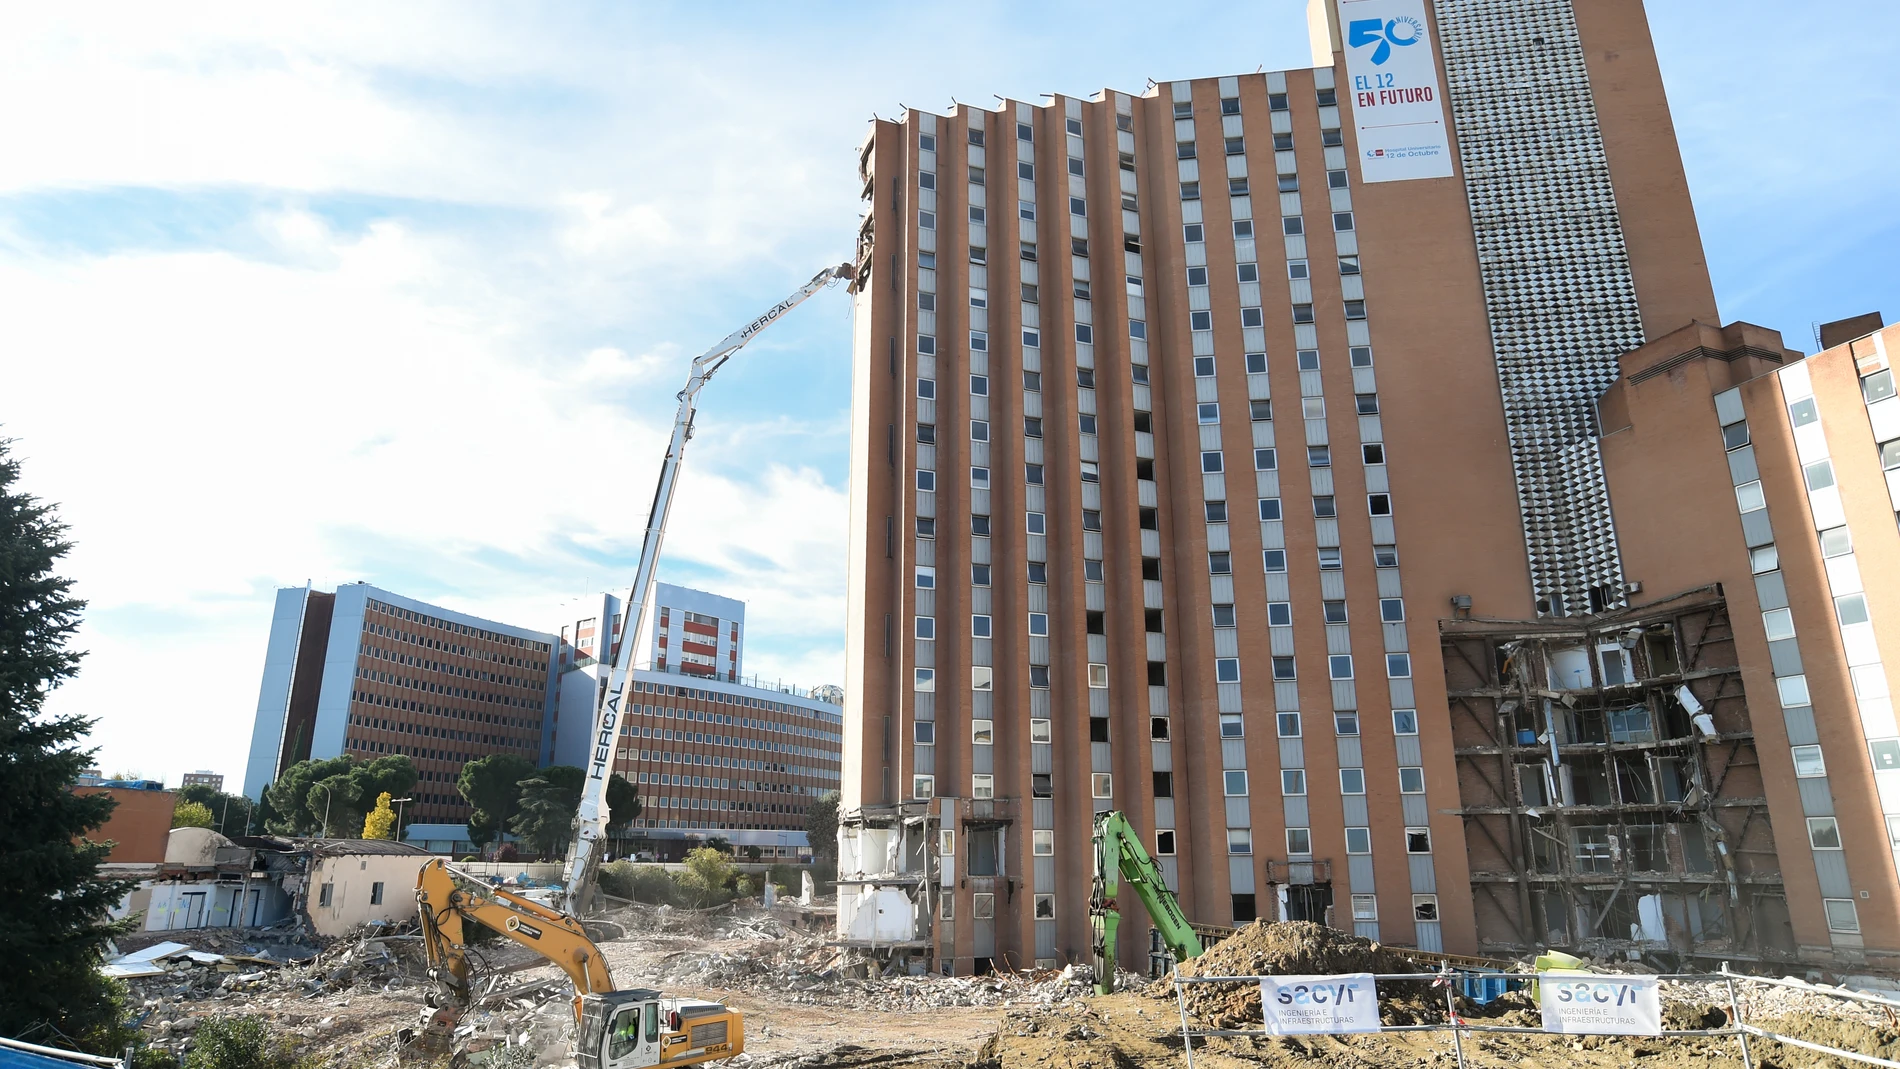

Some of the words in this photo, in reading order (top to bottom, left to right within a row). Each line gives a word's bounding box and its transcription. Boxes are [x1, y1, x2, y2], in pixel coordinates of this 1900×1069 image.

[1355, 75, 1372, 90] EL
[1376, 73, 1394, 88] 12
[1358, 92, 1375, 107] EN
[1380, 86, 1433, 105] FUTURO
[1408, 149, 1439, 157] Octubre
[743, 300, 794, 338] HERCAL
[591, 682, 625, 780] HERCAL
[1279, 1008, 1321, 1016] INGENIERÍA
[1559, 1007, 1601, 1015] INGENIERÍA
[1280, 1017, 1354, 1025] INFRAESTRUCTURAS
[1560, 1016, 1636, 1025] INFRAESTRUCTURAS
